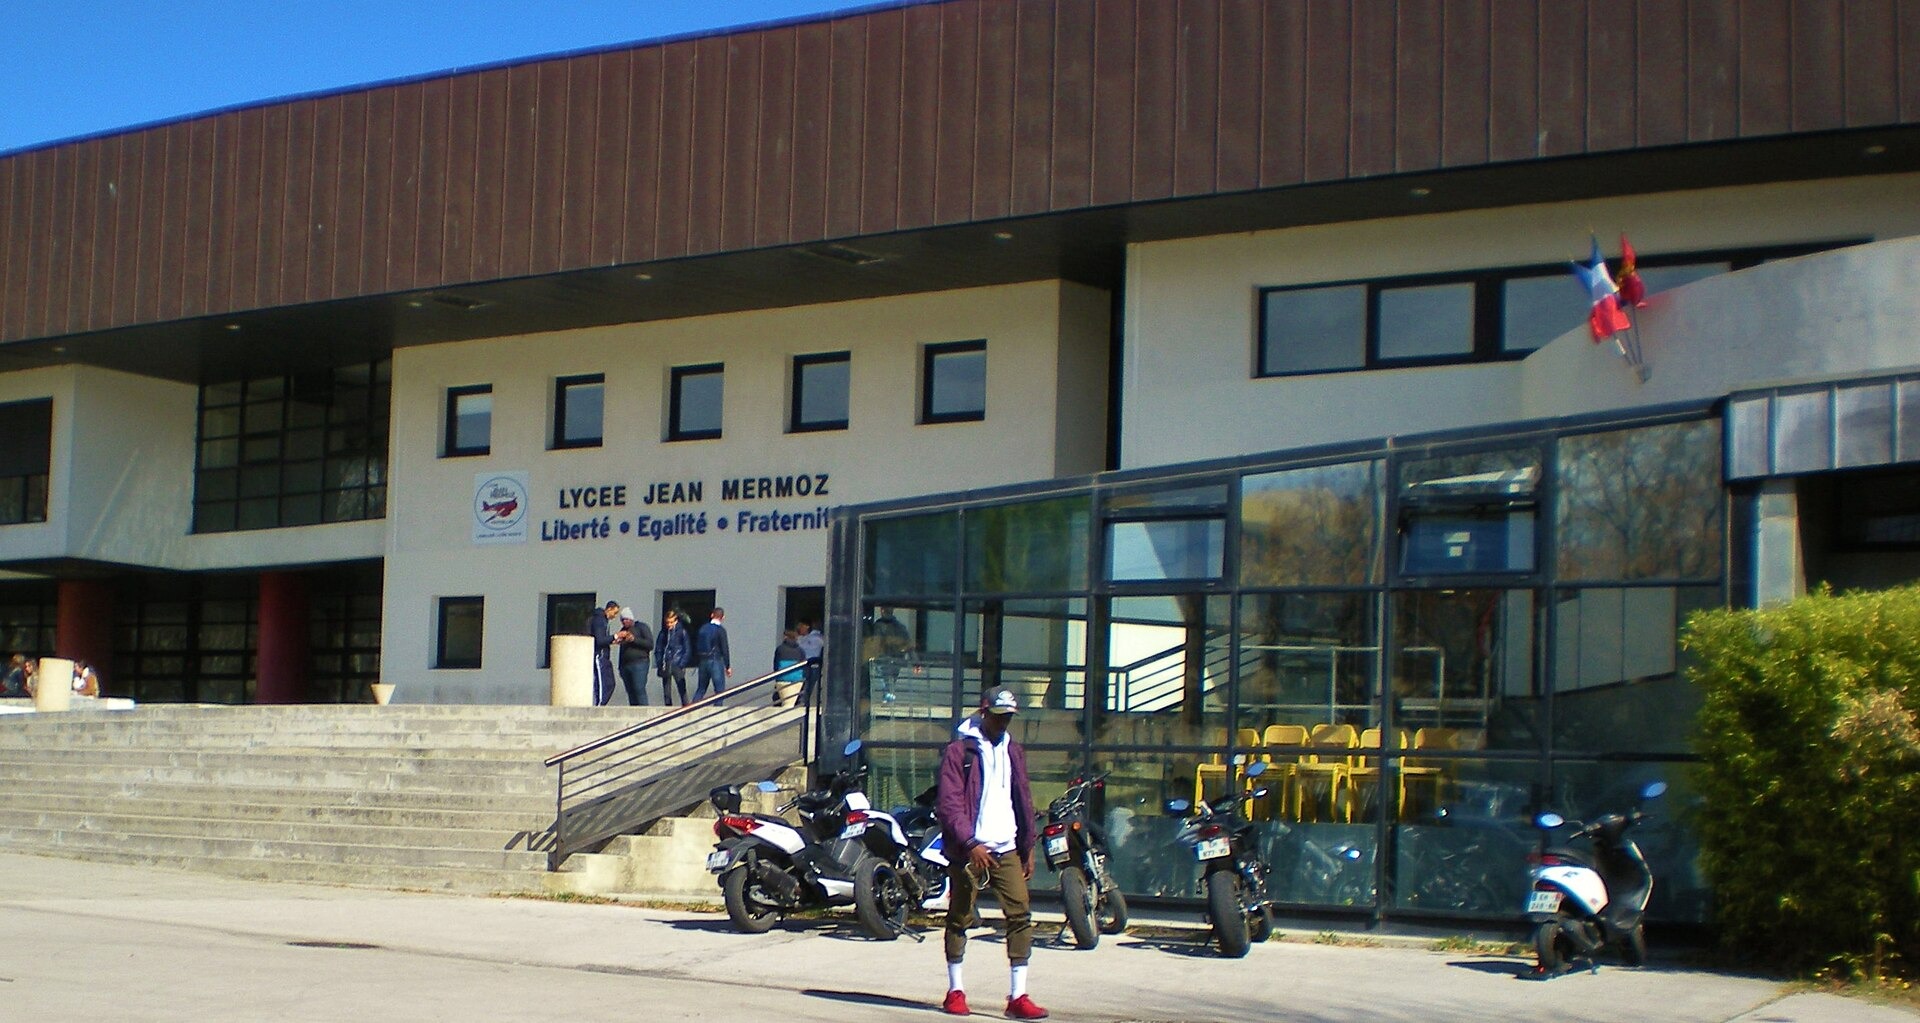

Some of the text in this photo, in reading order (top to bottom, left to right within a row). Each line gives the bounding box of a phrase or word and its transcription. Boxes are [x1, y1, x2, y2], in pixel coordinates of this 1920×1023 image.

[559, 473, 829, 509] LYCEE JEAN MERMOZ
[541, 506, 830, 542] Liberté Egalité Fraternit
